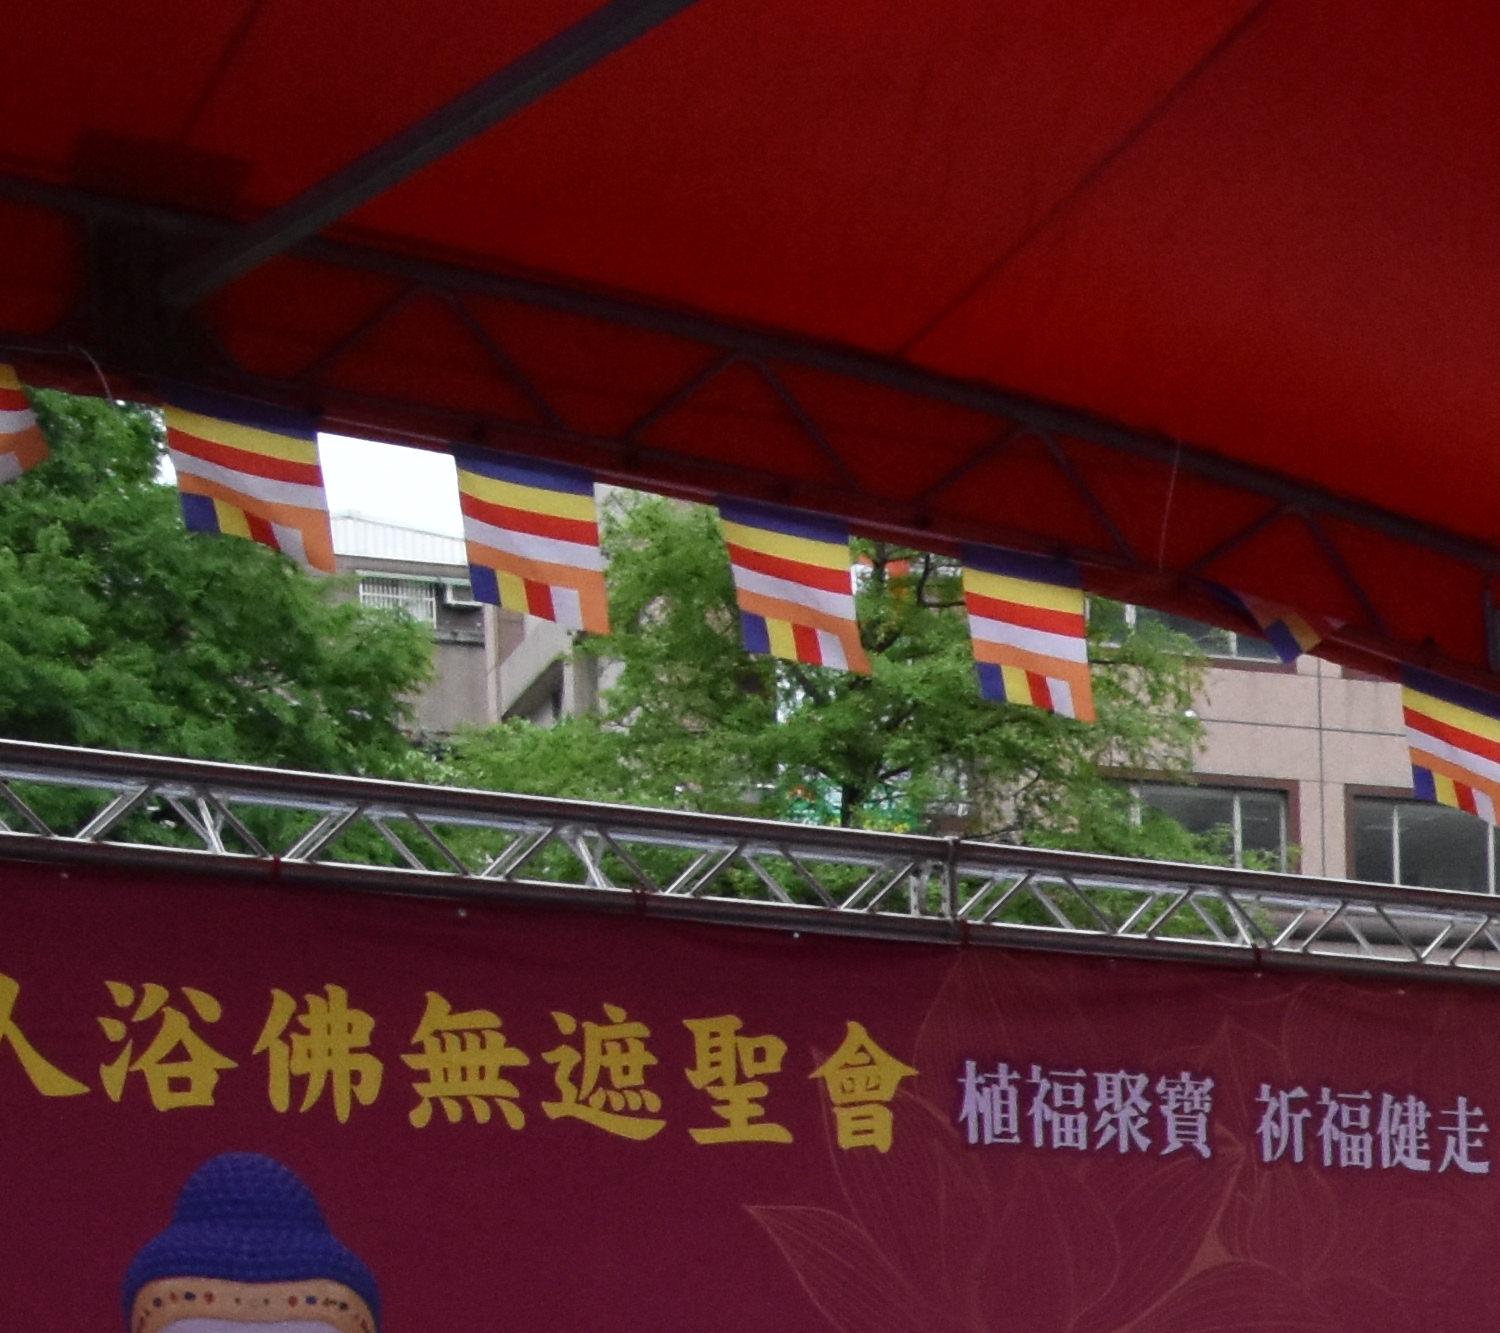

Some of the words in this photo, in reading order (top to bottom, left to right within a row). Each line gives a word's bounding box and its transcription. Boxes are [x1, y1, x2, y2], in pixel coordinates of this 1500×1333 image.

[958, 1060, 1213, 1159] 植福聚寶
[1256, 1083, 1491, 1175] 祈福健走
